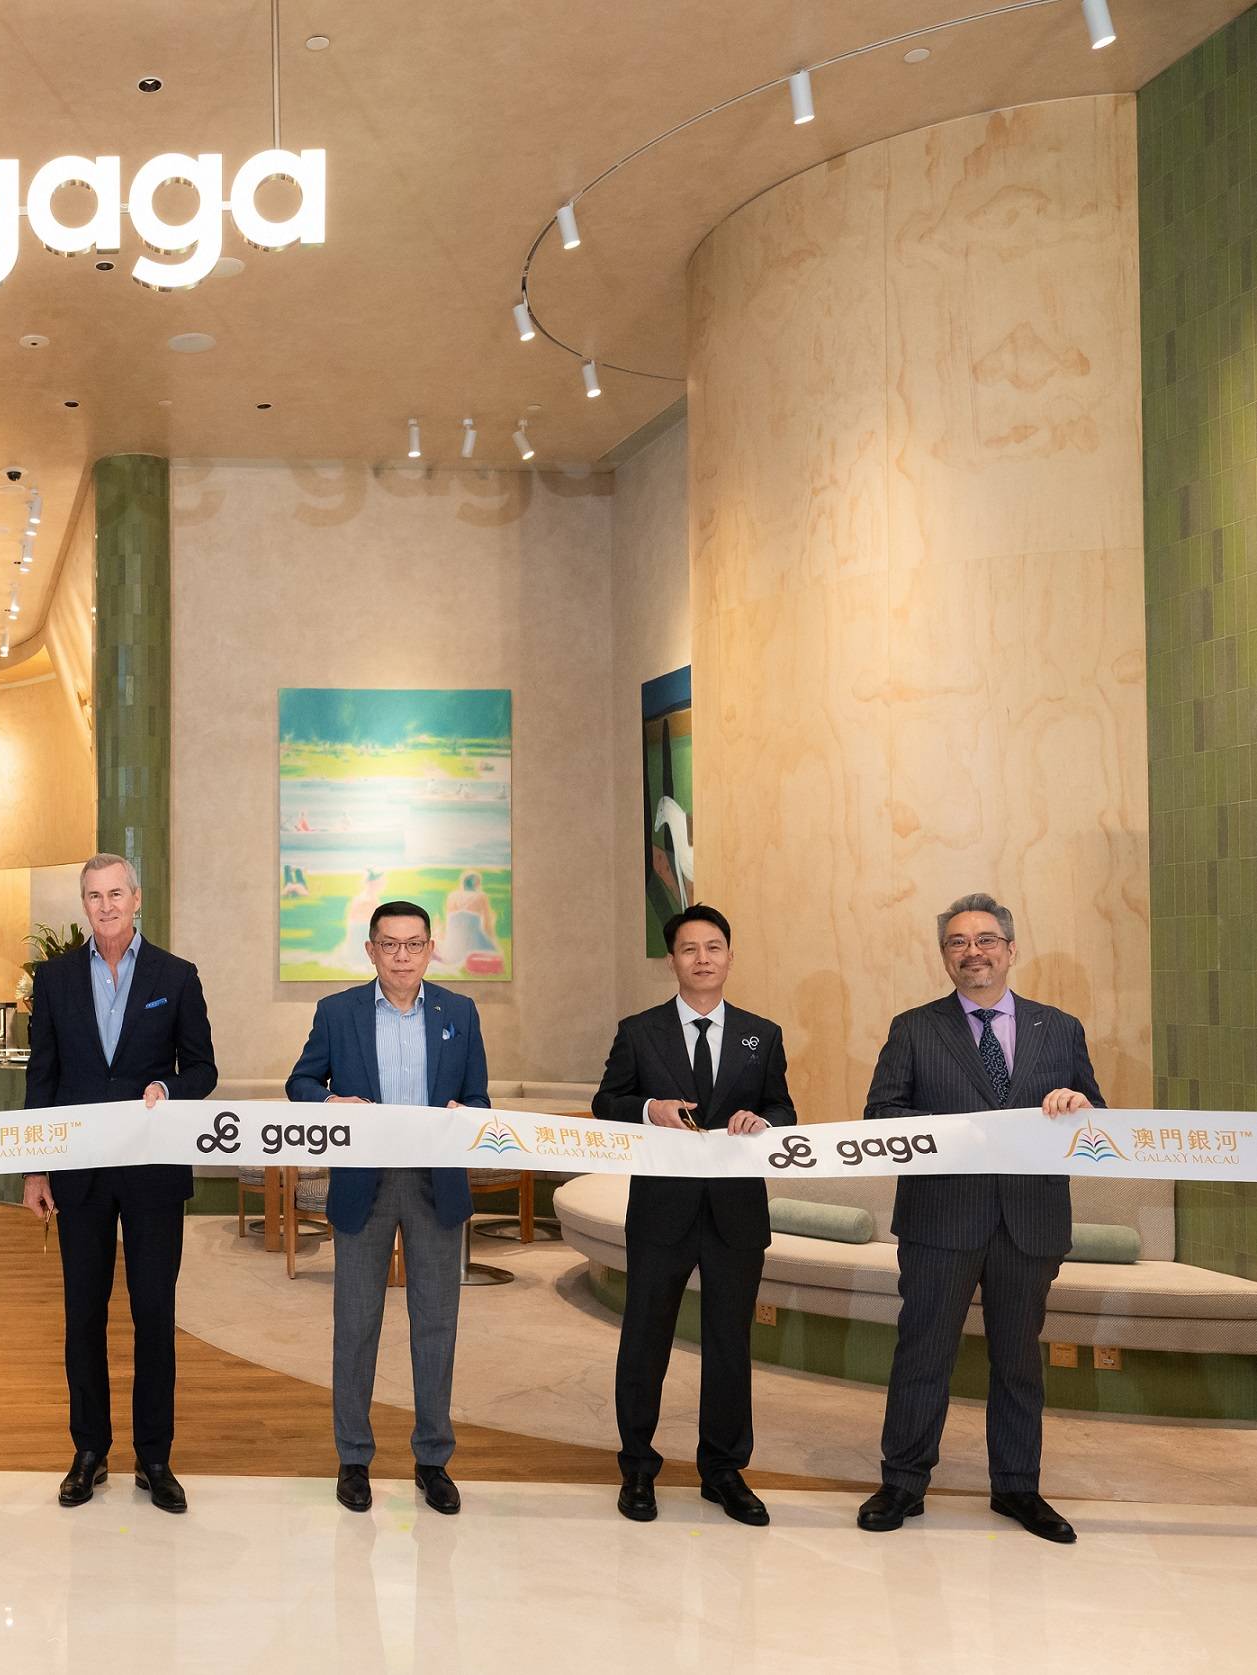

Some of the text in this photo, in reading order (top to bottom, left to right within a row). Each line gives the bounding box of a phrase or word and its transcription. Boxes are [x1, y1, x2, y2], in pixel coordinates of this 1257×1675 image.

[261, 1124, 351, 1155] gaga
[25, 1145, 69, 1156] MACAU
[536, 1144, 587, 1160] GALAXY
[836, 1134, 938, 1166] gaga
[1134, 1151, 1240, 1165] GALAXY MACAU
